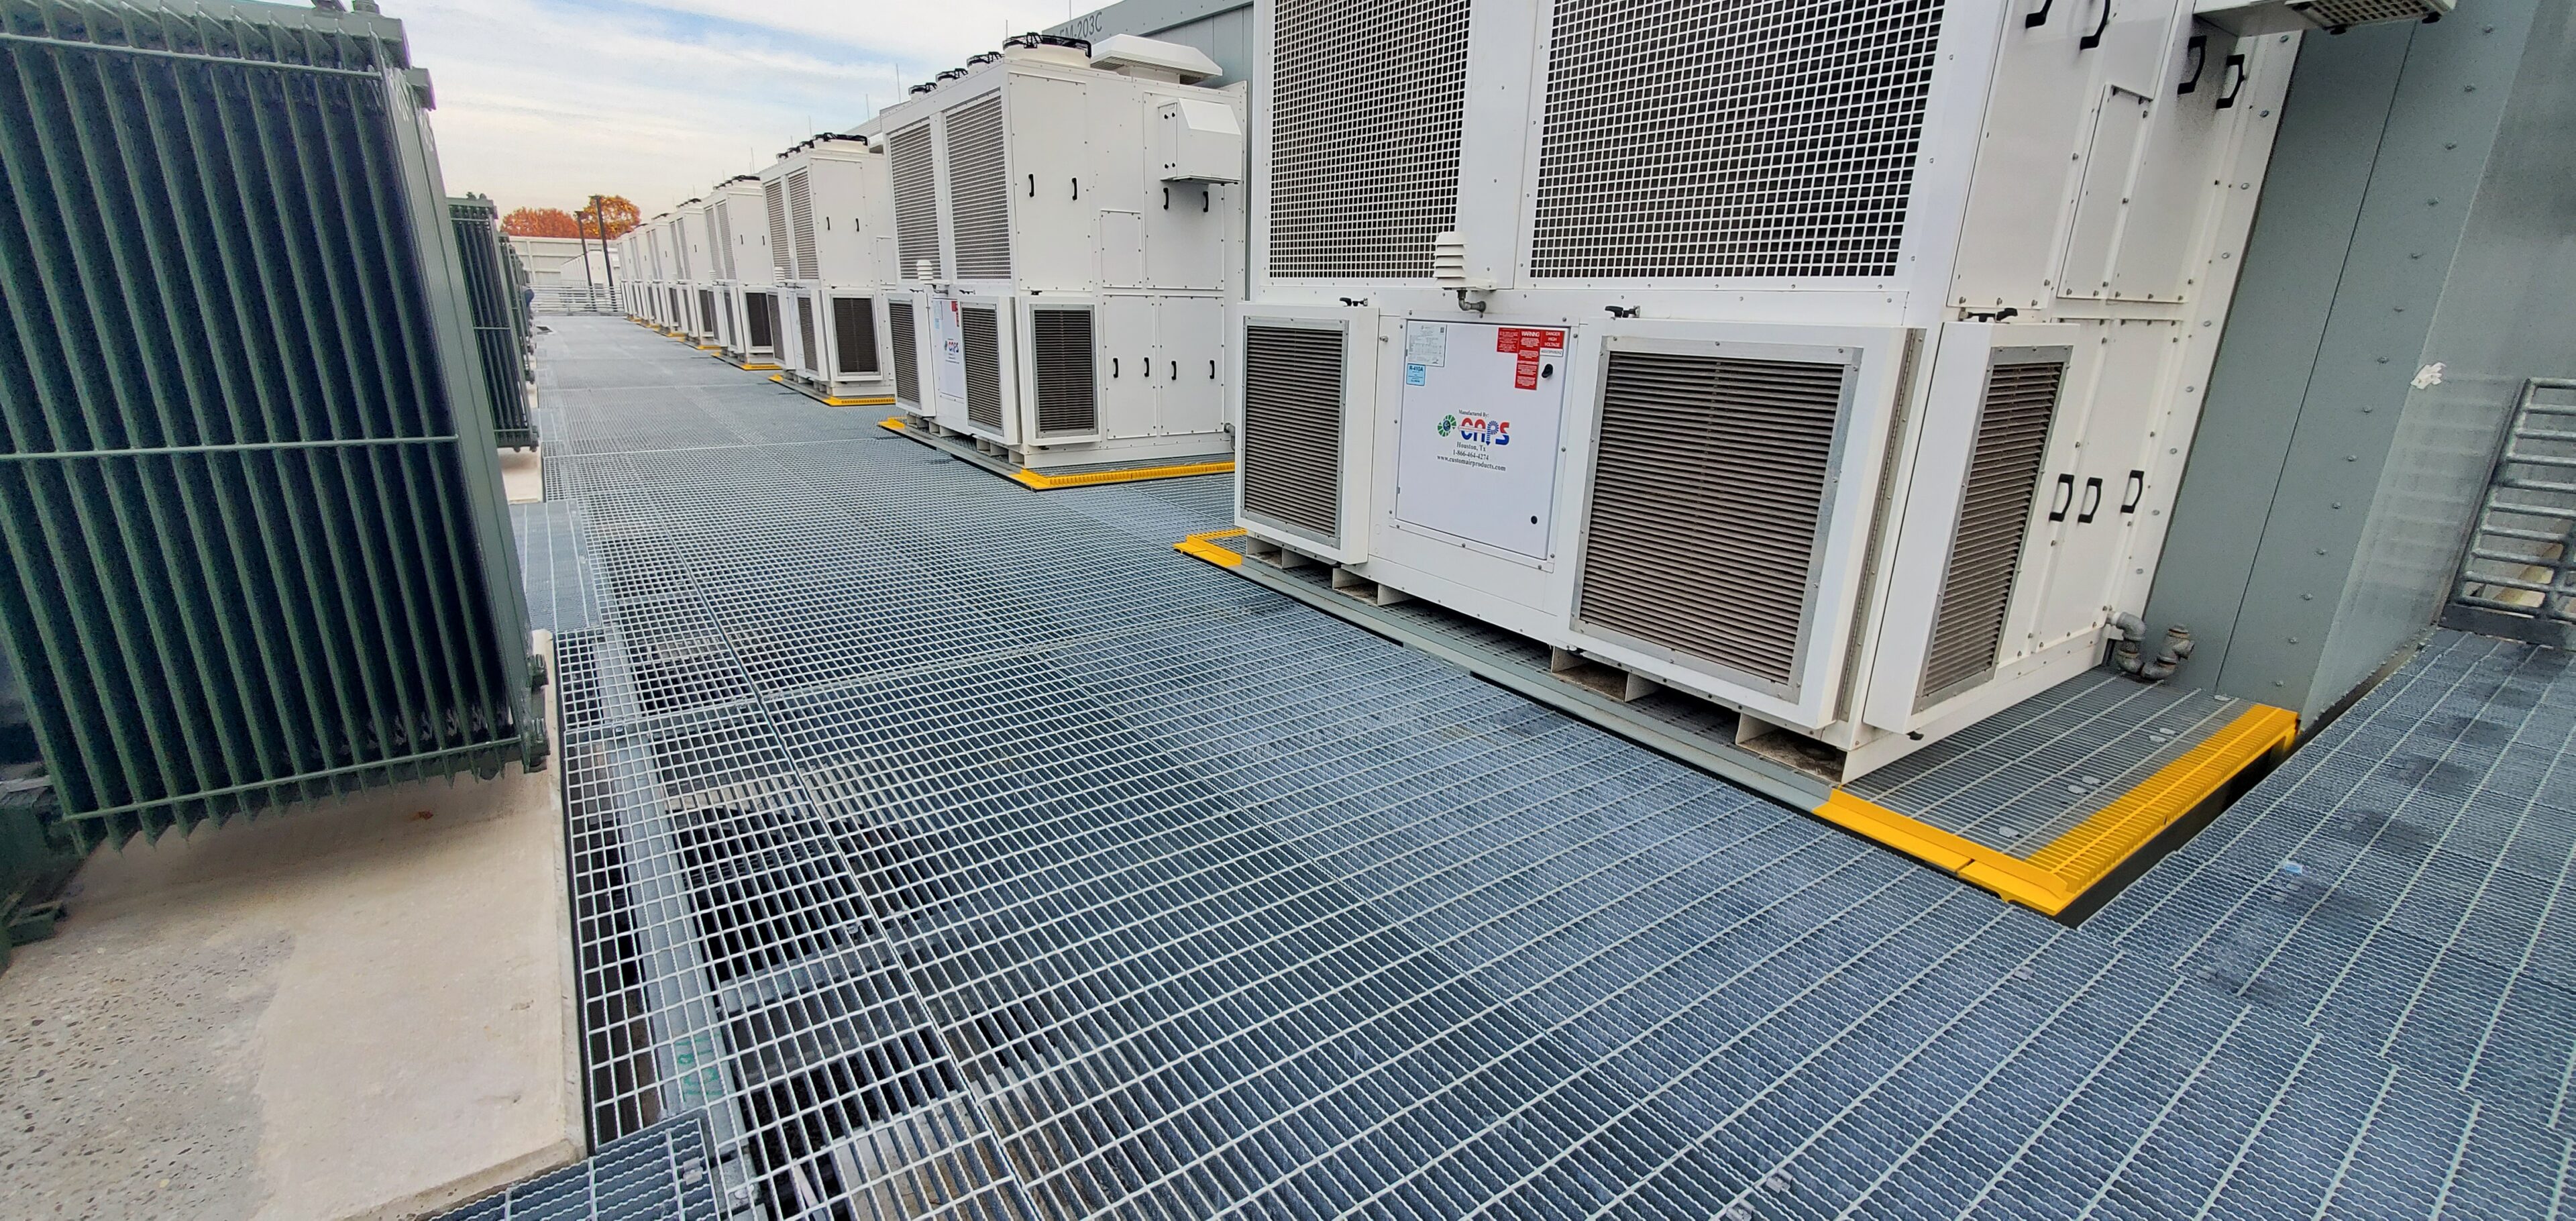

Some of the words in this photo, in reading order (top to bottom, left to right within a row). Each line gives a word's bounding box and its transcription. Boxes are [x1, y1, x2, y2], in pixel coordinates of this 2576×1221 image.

[1456, 441, 1479, 451] Houston,
[1453, 449, 1489, 461] 1-866-464-4274
[1437, 456, 1506, 471] www.customairproducts.com
